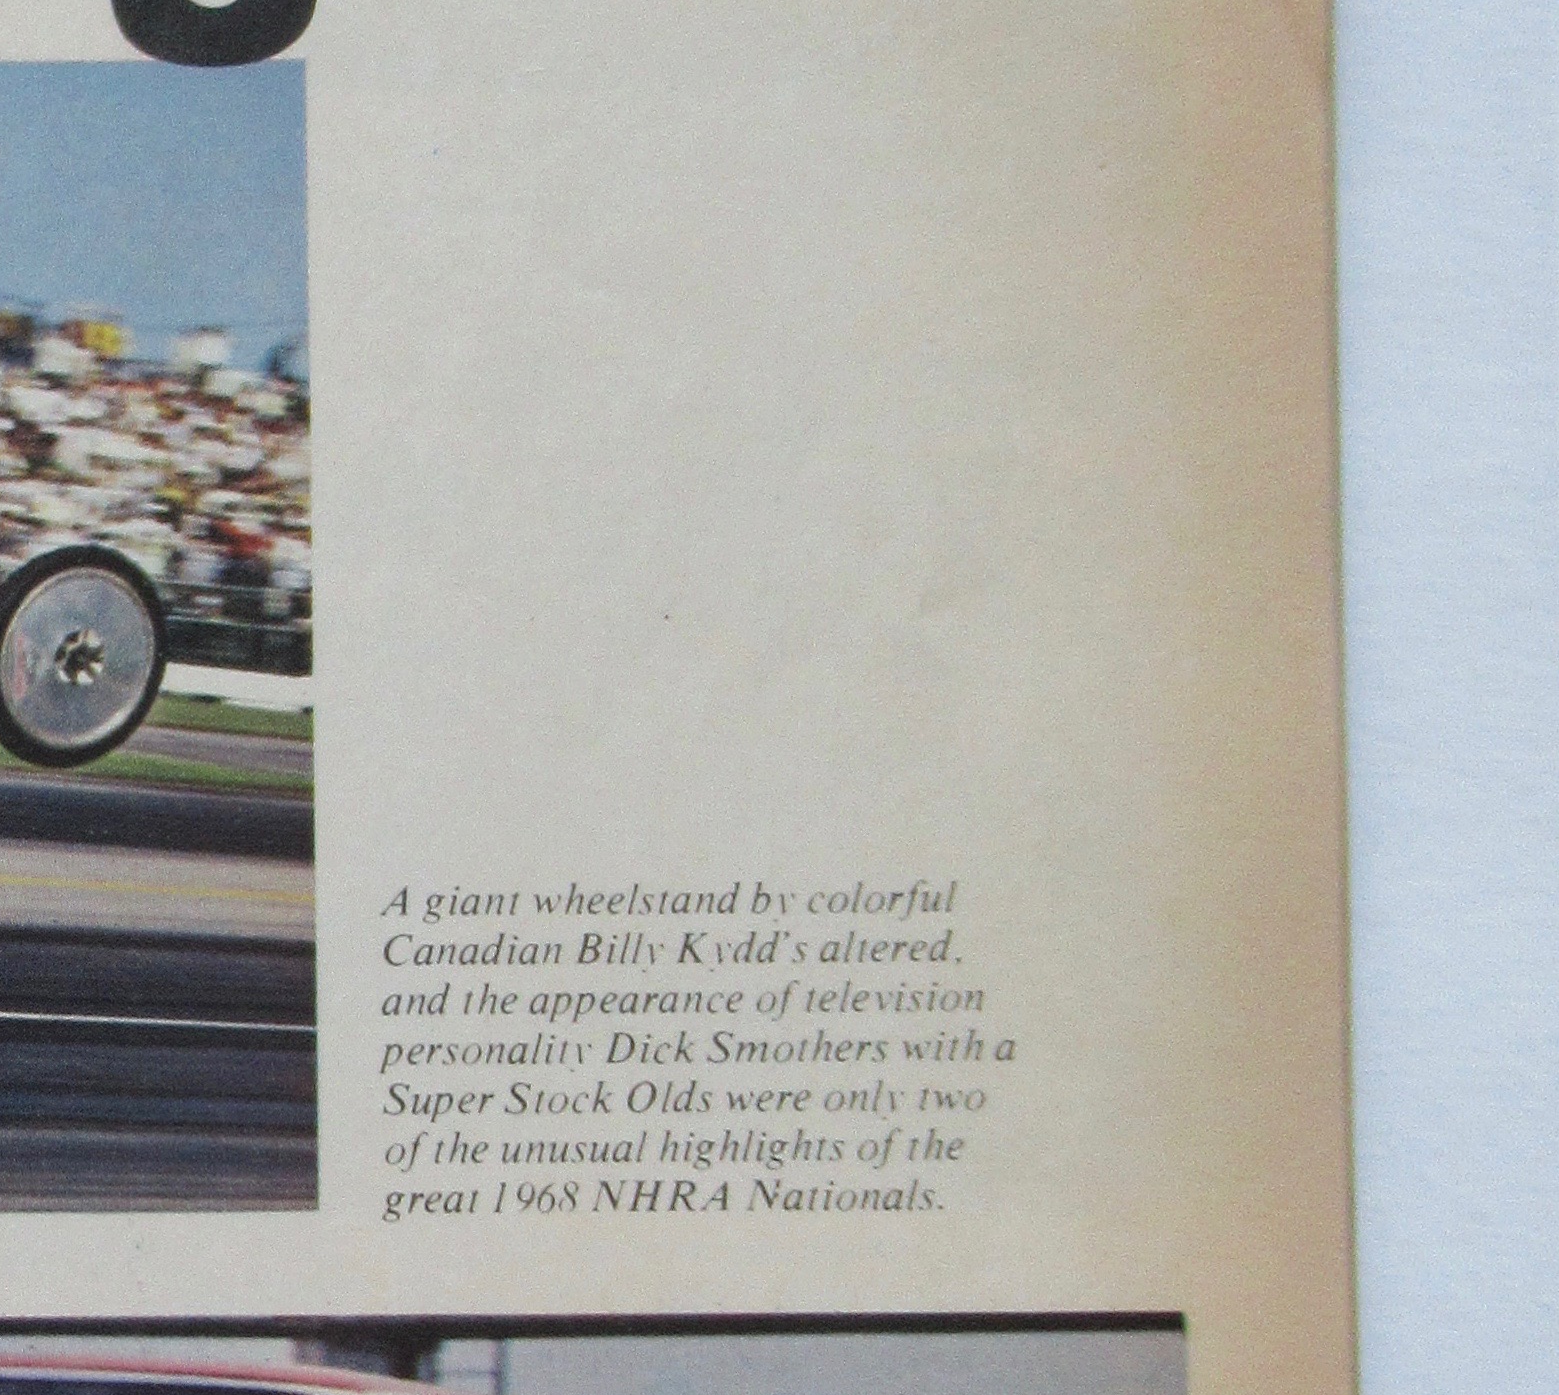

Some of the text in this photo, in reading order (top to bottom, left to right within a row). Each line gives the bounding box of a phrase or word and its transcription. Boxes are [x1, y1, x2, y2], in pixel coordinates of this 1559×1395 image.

[380, 886, 409, 917] A
[422, 885, 520, 924] giant
[533, 881, 741, 916] wheelstand
[807, 879, 958, 921] colorful
[382, 932, 563, 967] Canadian
[576, 932, 665, 973] Billy
[380, 980, 985, 1023] and the appearance of television
[379, 1028, 1016, 1075] personality Dick Smothers with a
[382, 1079, 987, 1124] Super Stock Olds were only two
[384, 1127, 965, 1173] of the unusual highlights of the
[381, 1178, 944, 1223] great 1968 NHRA Nationals.
